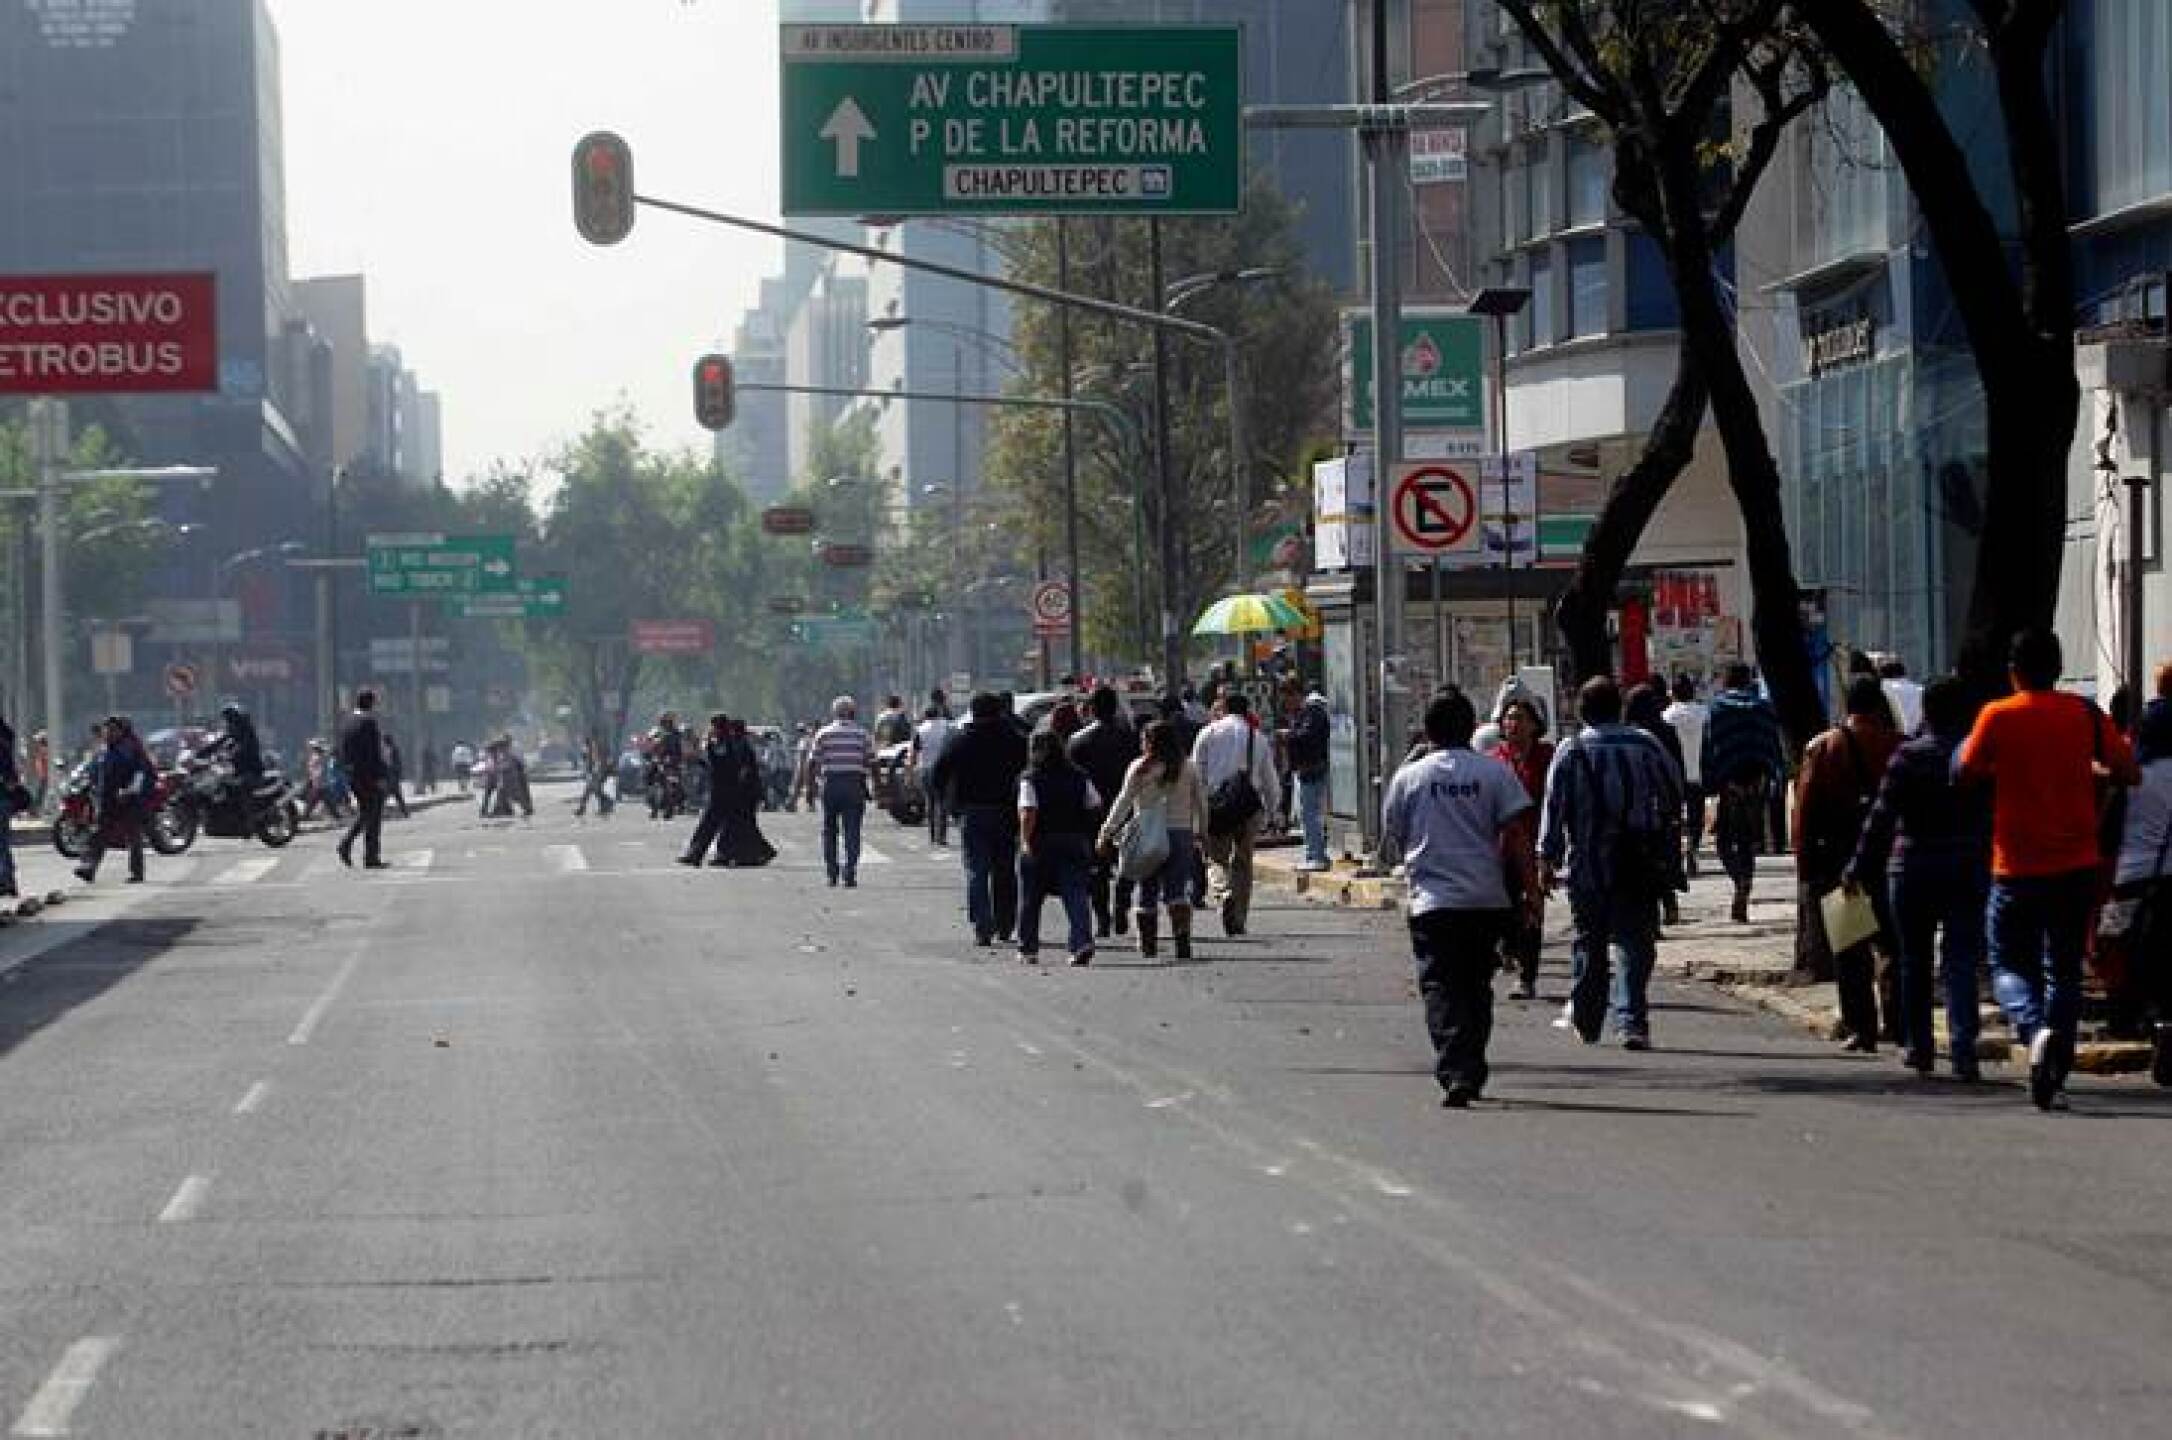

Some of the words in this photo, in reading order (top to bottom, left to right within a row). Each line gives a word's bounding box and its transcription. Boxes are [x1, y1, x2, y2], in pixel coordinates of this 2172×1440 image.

[827, 30, 928, 51] INSURGENTES
[936, 30, 995, 51] CENTRO
[909, 72, 950, 108] AV
[967, 71, 1206, 108] CHAPULTEPEC
[909, 118, 932, 155] P
[945, 118, 986, 155] DE
[1001, 118, 1042, 154] LA
[1055, 118, 1207, 154] REFORMA
[956, 169, 1129, 194] CHAPULTEPEC
[0, 342, 183, 376] ETROBUS
